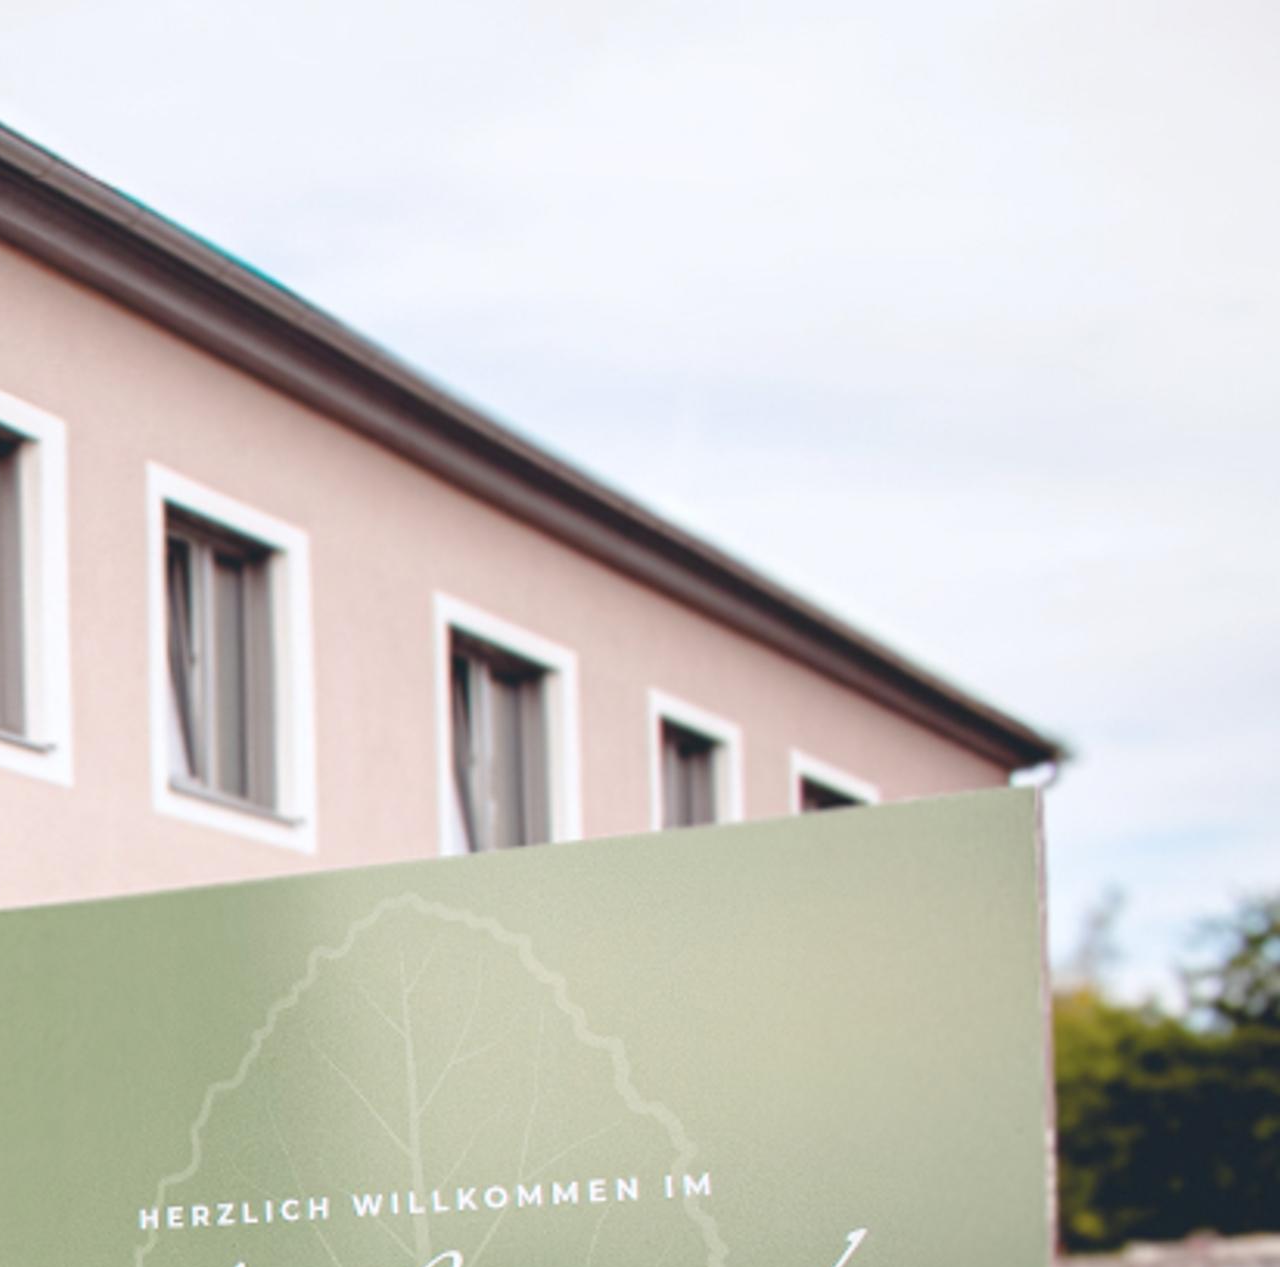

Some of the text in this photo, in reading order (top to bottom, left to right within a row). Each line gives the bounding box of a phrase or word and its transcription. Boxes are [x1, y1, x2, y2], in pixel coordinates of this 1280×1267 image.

[138, 1172, 714, 1231] HERZLICH WILLKOMMEN IM
